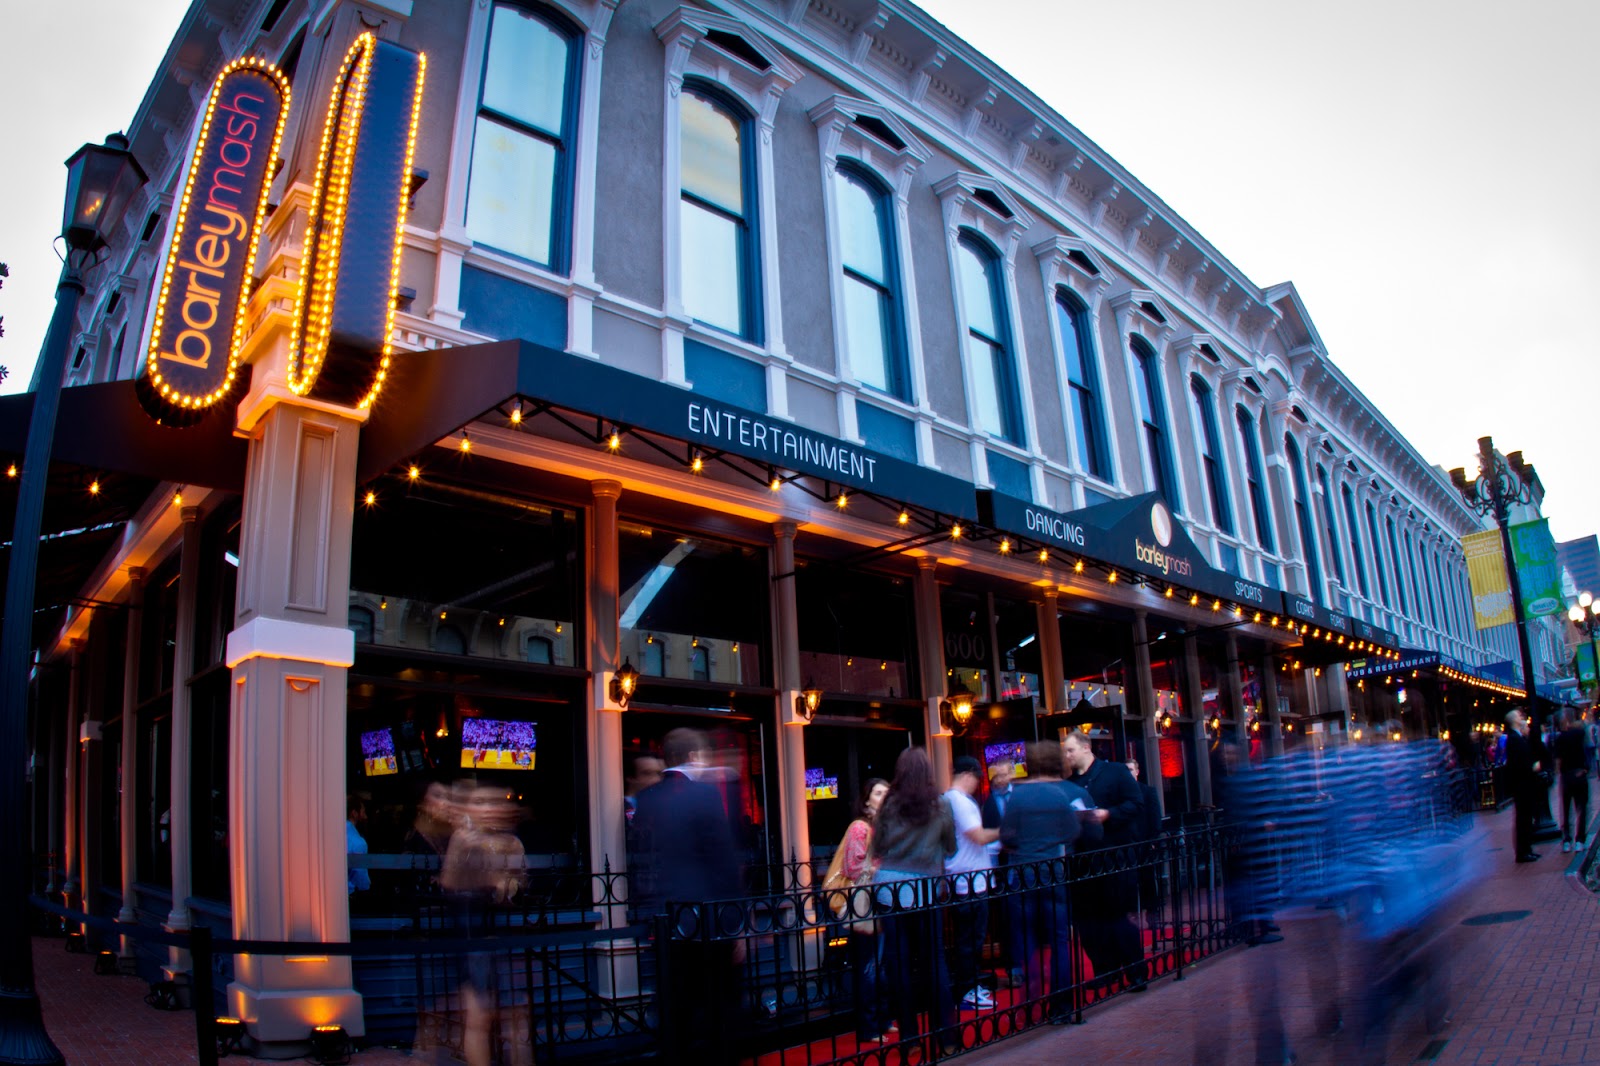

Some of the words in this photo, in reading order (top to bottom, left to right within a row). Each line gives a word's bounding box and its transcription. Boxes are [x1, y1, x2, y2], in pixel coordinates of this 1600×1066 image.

[160, 92, 264, 369] barleymash
[688, 403, 876, 483] ENTERTAINMENT
[1025, 508, 1085, 546] DANCING
[1135, 538, 1192, 577] barleymash
[1234, 580, 1262, 602] SPORTS
[1295, 600, 1314, 618] CORKS
[945, 631, 986, 660] 600
[1347, 669, 1365, 678] PUB
[1375, 655, 1437, 672] RESTAURANT
